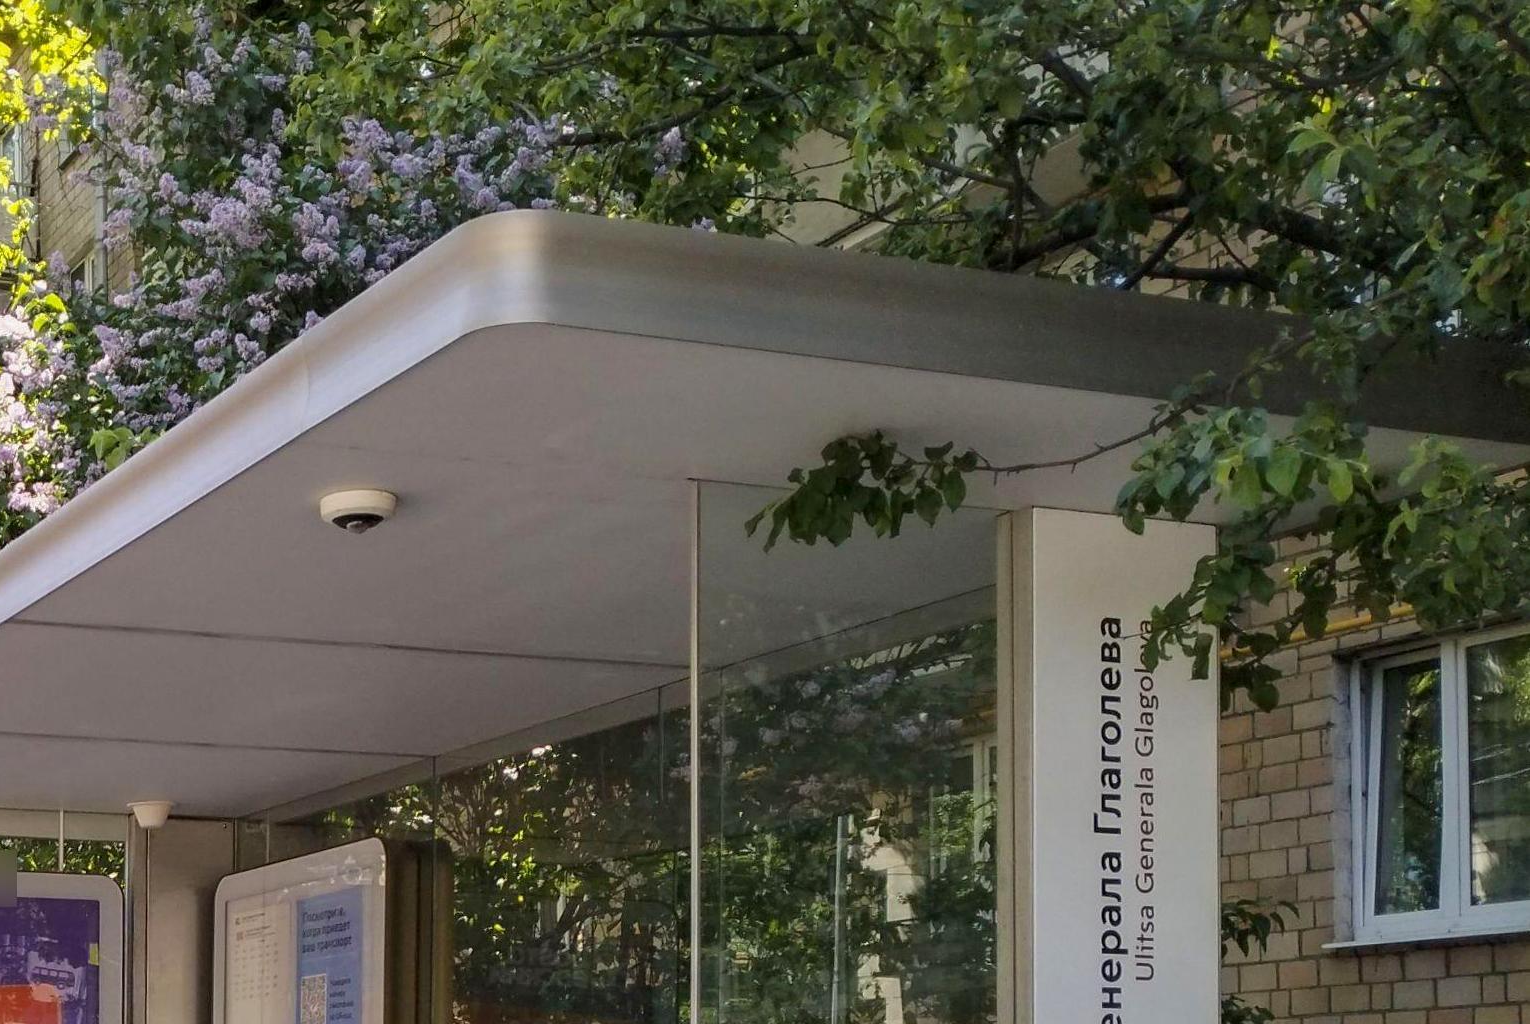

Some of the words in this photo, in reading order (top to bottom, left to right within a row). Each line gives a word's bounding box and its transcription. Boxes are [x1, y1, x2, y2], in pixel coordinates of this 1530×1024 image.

[1093, 615, 1123, 835] Глаголева
[1135, 766, 1155, 894] Generala
[1135, 905, 1155, 982] Ulitsa
